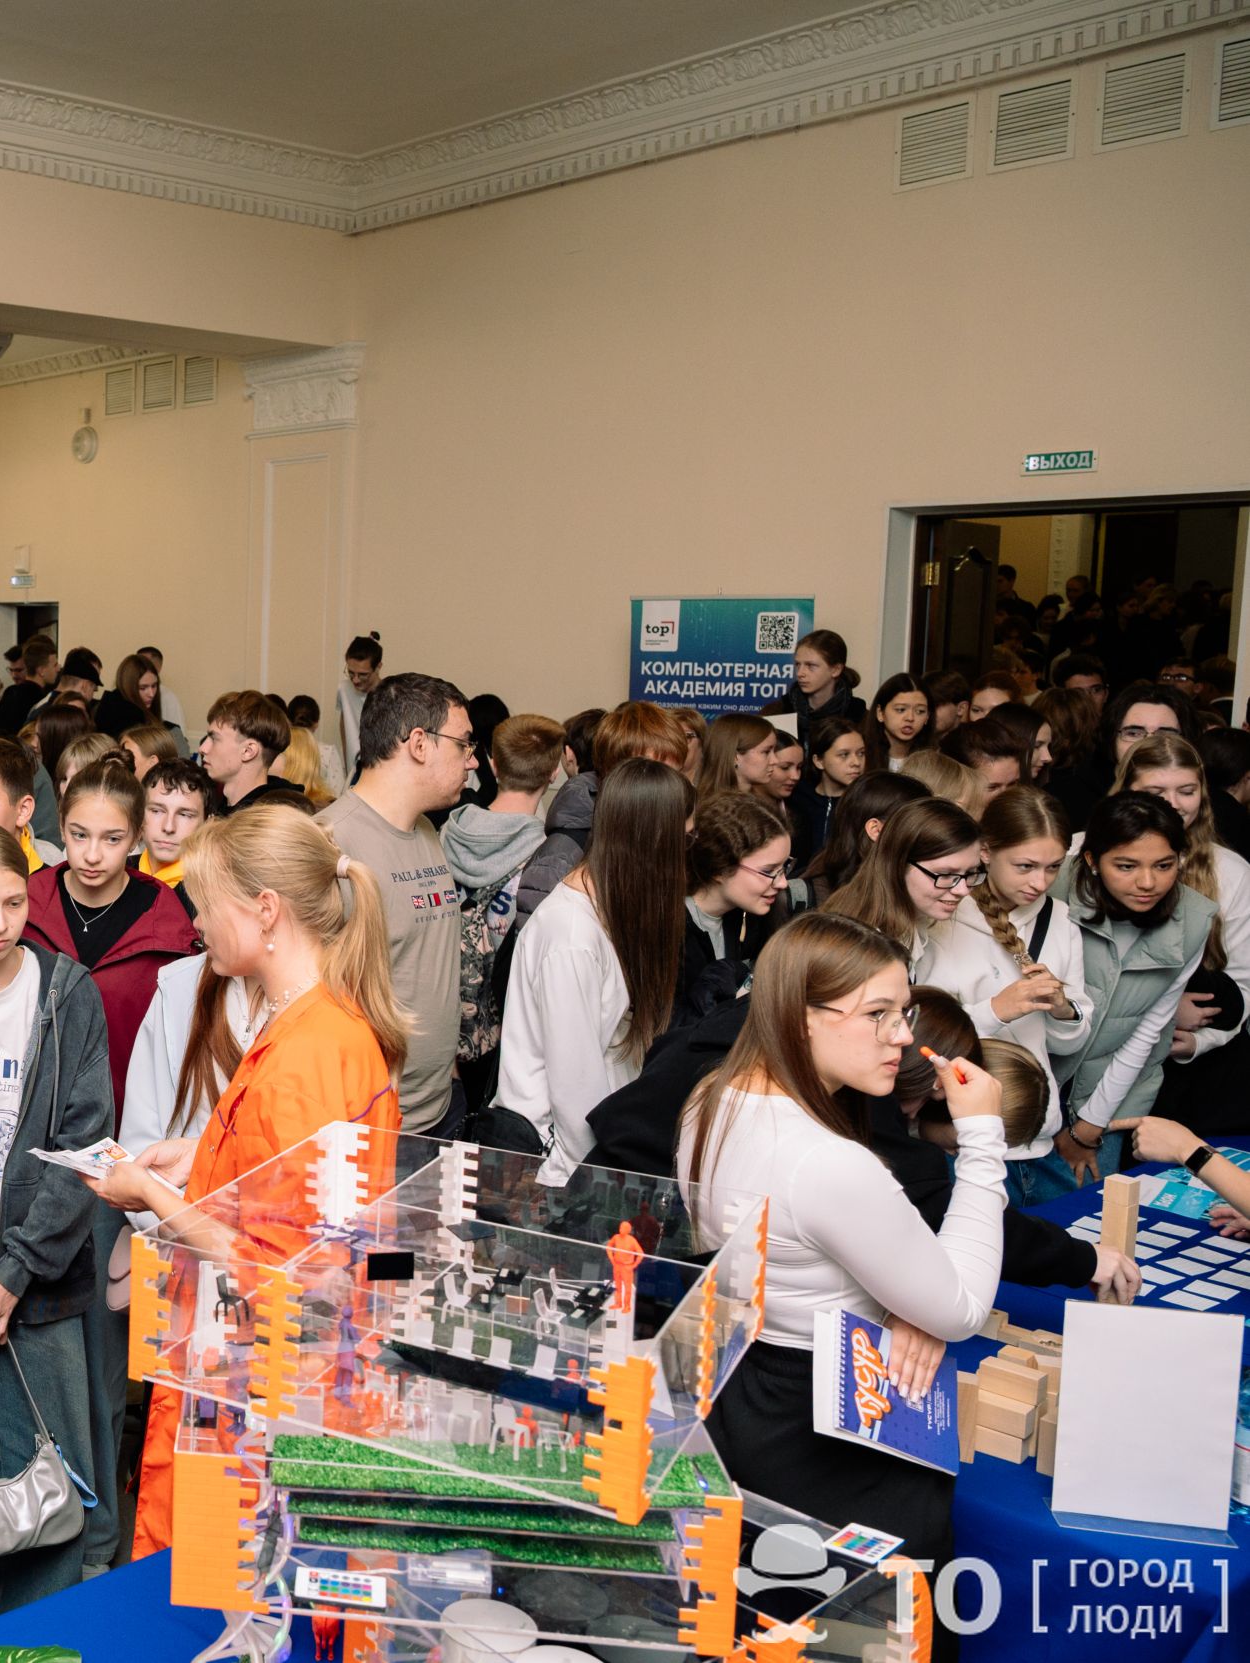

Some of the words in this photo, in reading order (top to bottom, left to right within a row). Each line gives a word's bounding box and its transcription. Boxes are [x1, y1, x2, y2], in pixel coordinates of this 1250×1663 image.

[1029, 452, 1090, 471] ВЫХОД
[645, 623, 670, 637] top
[641, 660, 794, 679] КОМПЬЮТЕРНАЯ
[644, 680, 745, 698] АКАДЕМИЯ
[750, 682, 788, 698] ТОП
[698, 703, 721, 711] каким
[391, 871, 416, 883] PAUL
[422, 864, 450, 878] SHARK
[852, 1329, 890, 1427] ТУСУР
